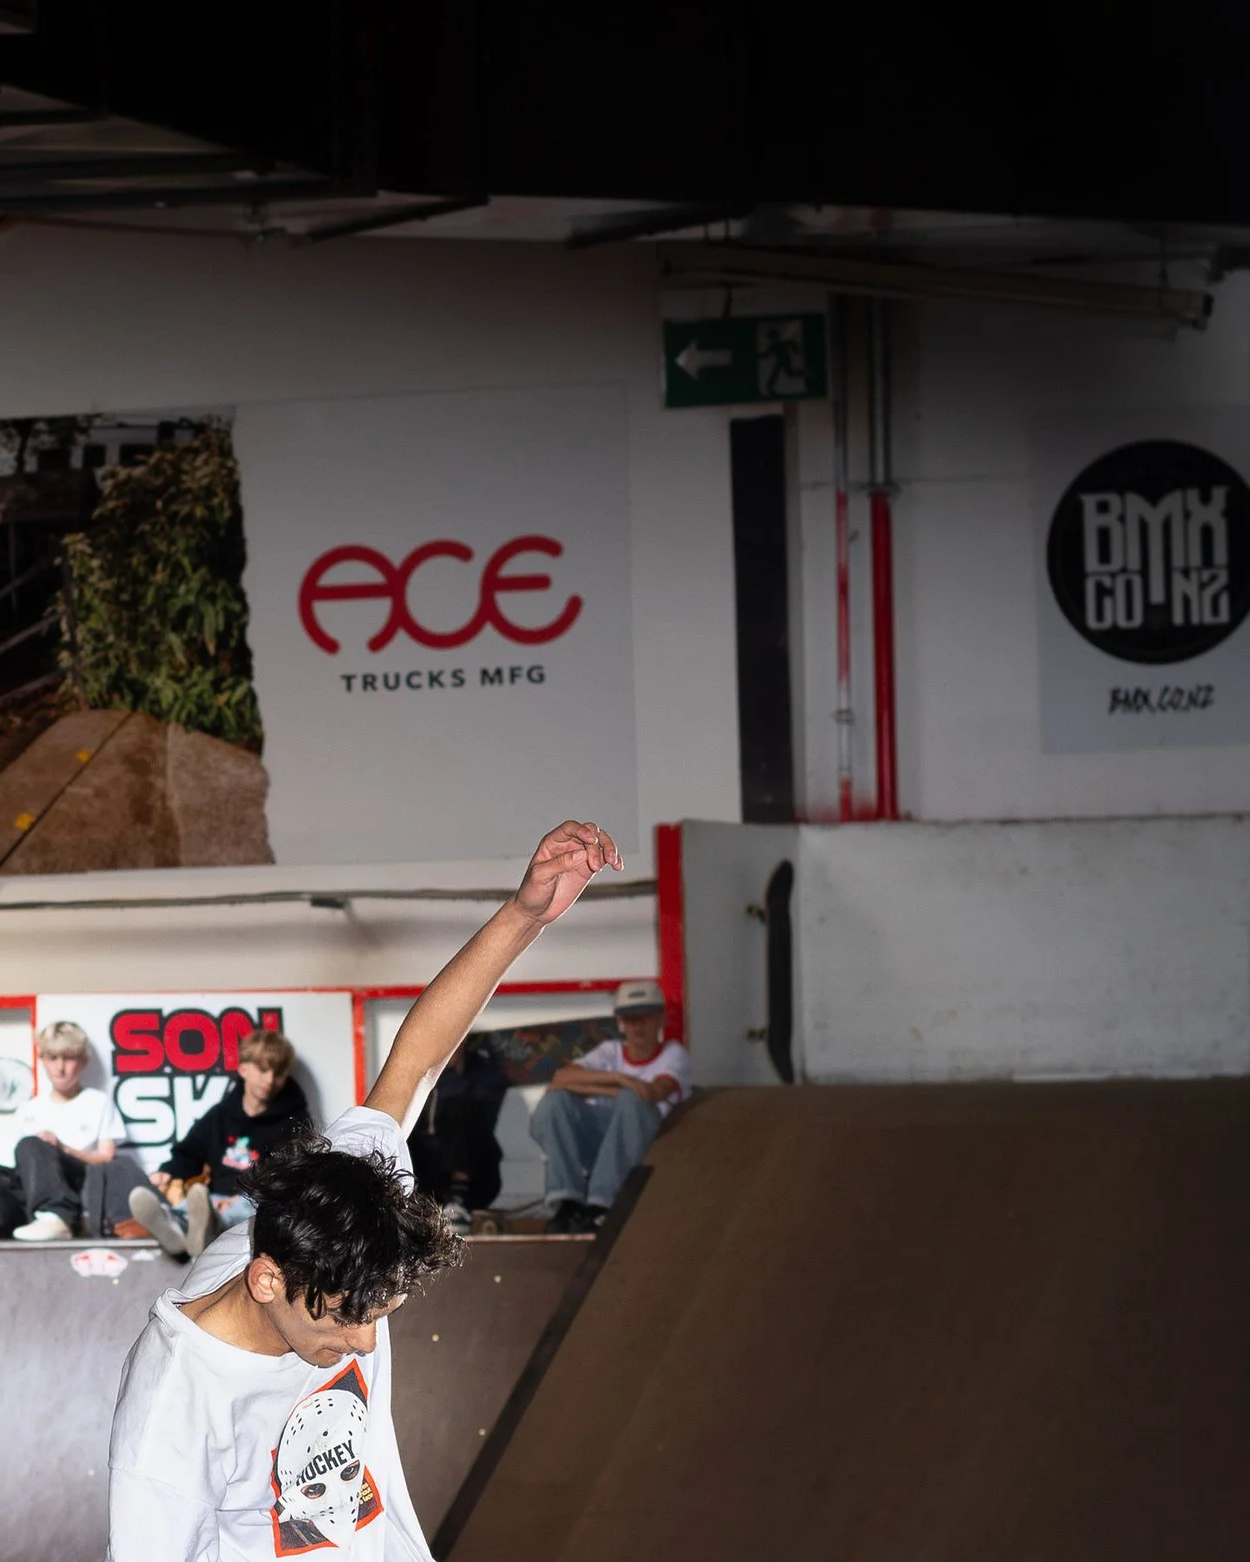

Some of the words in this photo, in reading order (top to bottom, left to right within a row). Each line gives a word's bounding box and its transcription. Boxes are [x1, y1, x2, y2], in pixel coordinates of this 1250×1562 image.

[297, 534, 583, 656] ACE
[1080, 486, 1229, 605] BMX
[341, 668, 466, 693] TRUCKS
[480, 664, 546, 687] MFG
